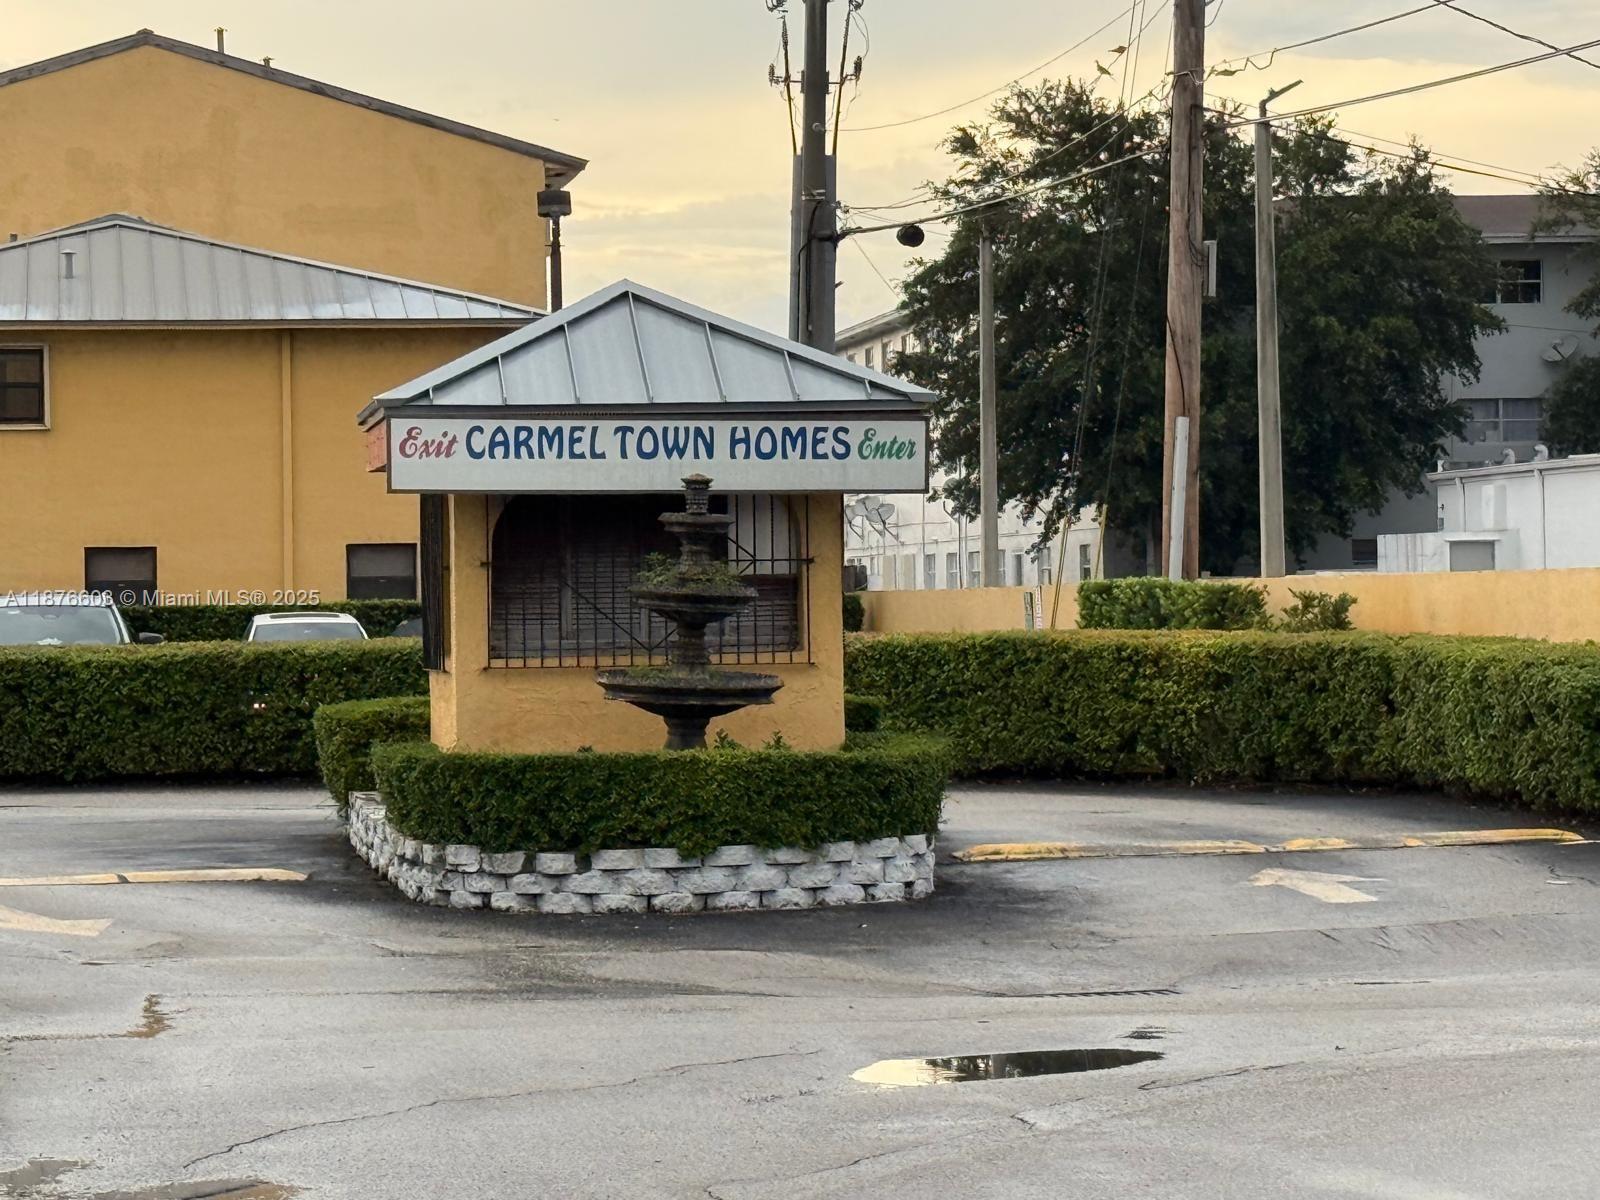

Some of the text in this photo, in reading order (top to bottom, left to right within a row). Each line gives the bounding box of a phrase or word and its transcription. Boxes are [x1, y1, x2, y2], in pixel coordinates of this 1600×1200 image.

[398, 425, 916, 461] Exit CARMEL TOWN HOMES Enter
